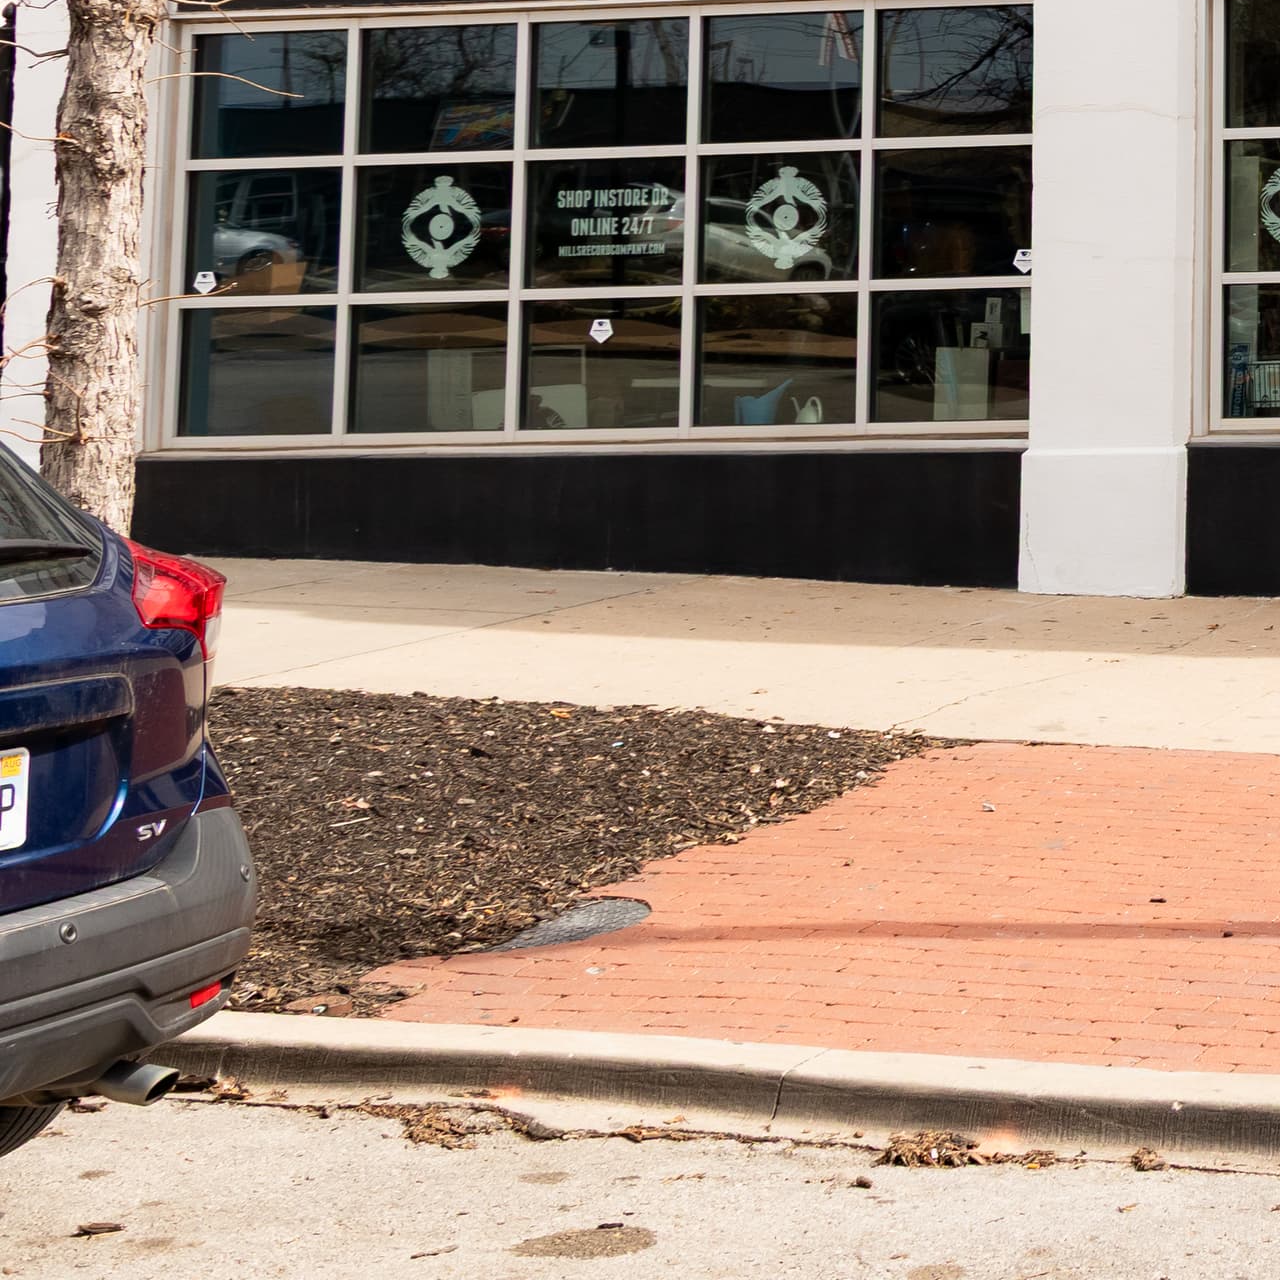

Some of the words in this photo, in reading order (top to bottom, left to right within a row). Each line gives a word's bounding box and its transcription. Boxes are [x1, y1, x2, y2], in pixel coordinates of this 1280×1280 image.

[557, 190, 592, 208] SHOP
[594, 188, 649, 207] INSTORE
[651, 187, 669, 206] OR
[571, 217, 619, 236] ONLINE
[622, 216, 654, 235] 24/7
[136, 818, 167, 842] SV
